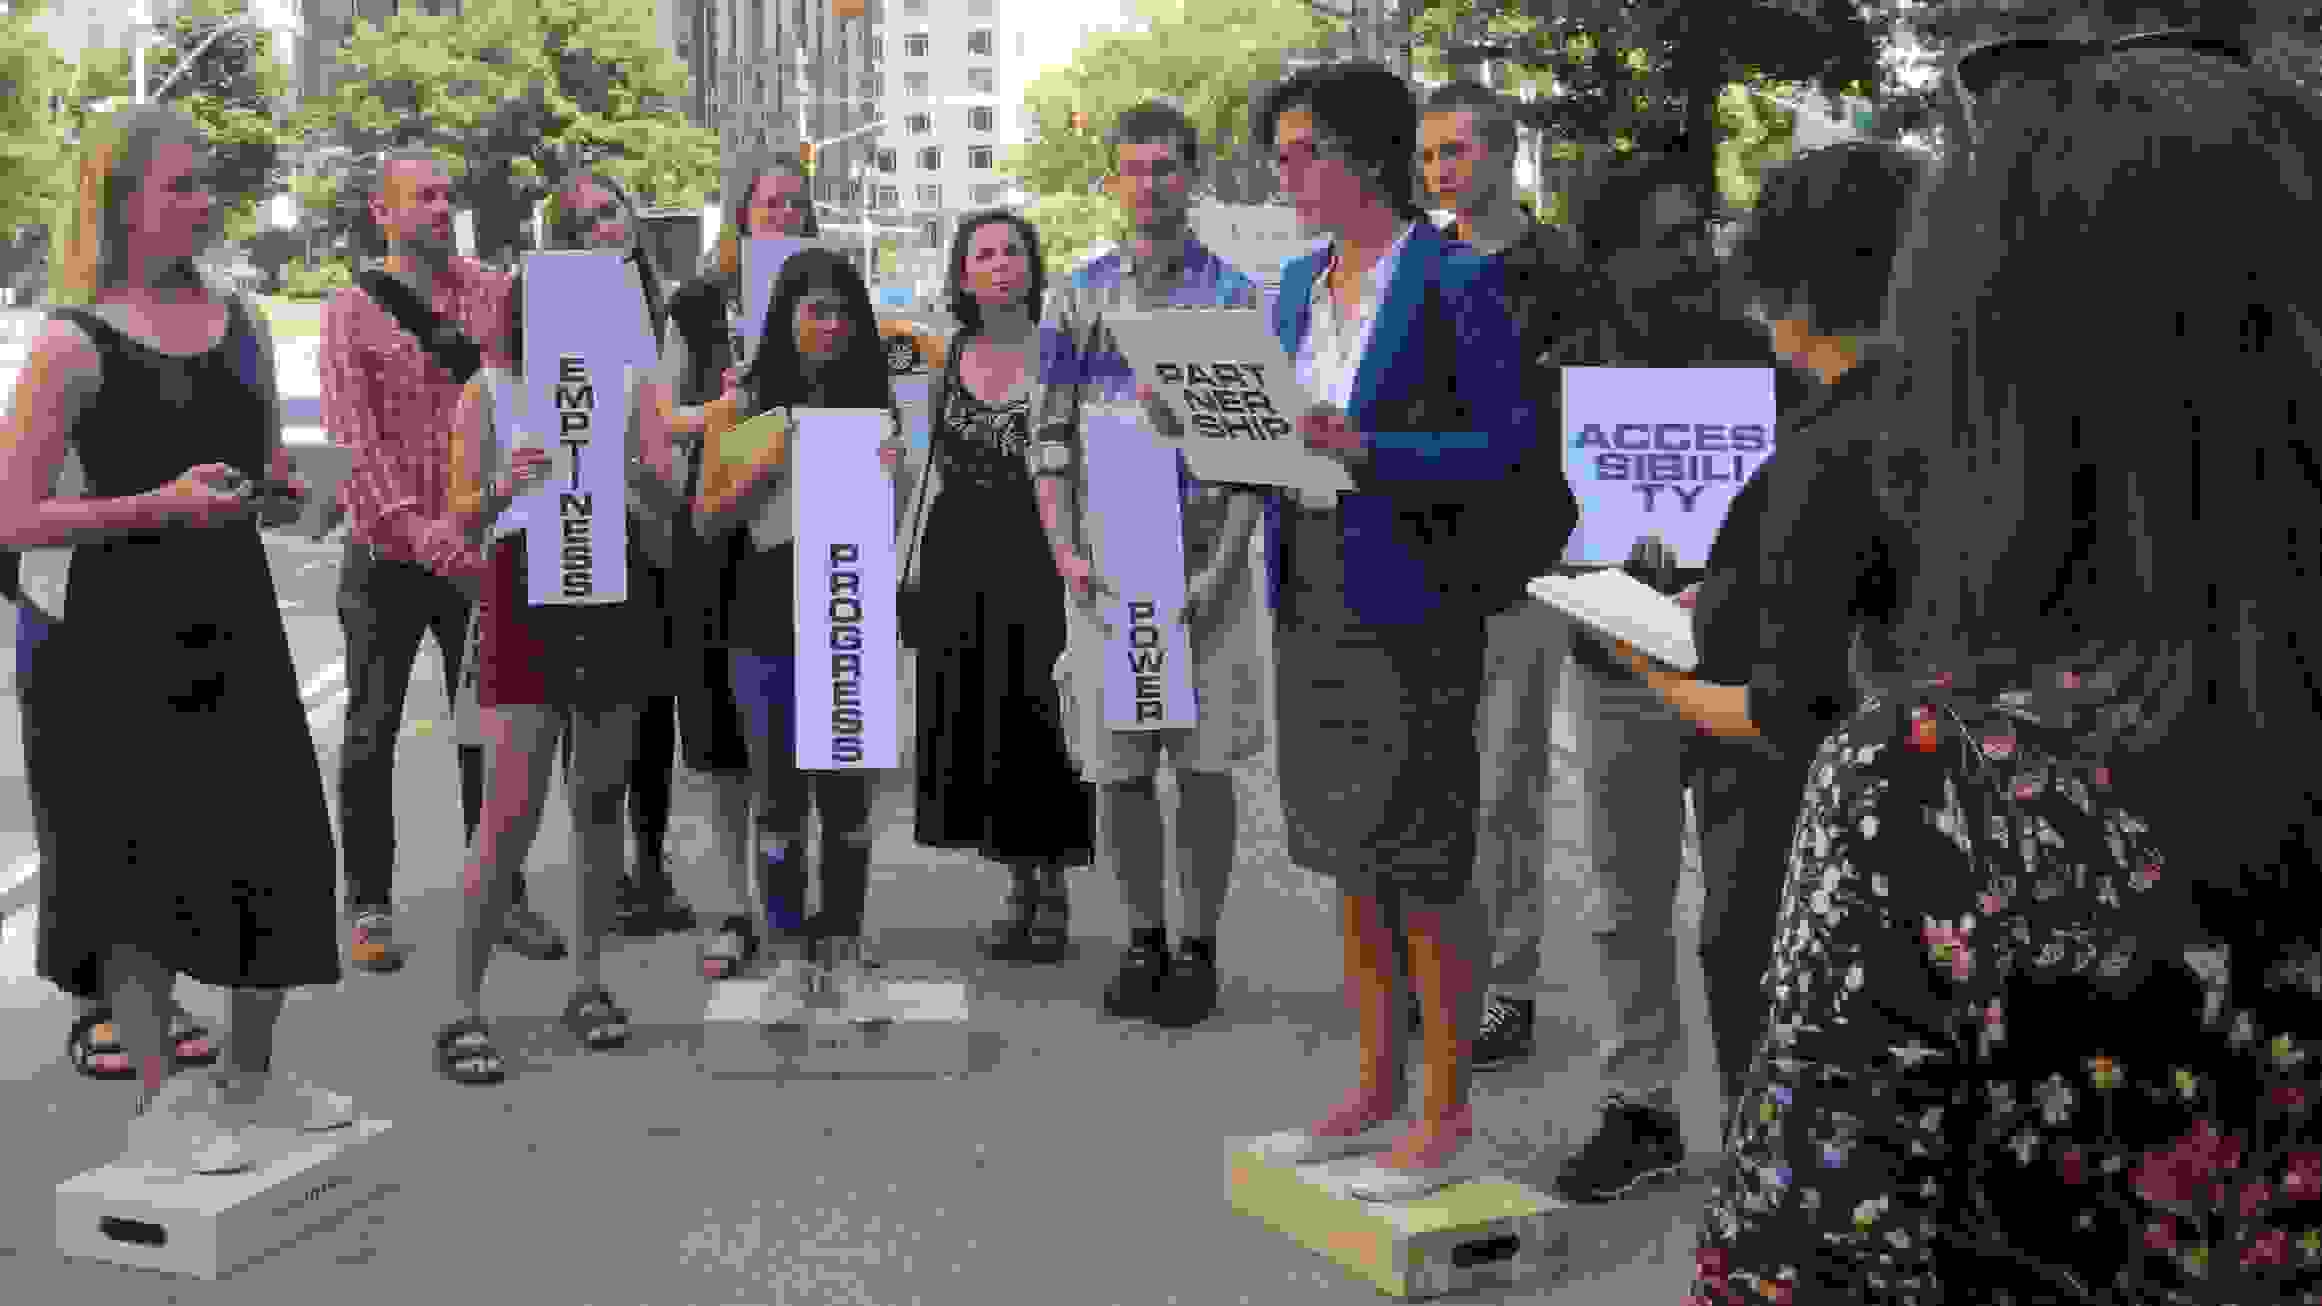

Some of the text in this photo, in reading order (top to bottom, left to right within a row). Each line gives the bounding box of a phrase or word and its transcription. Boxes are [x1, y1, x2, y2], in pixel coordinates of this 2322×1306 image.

[1155, 363, 1264, 385] PART
[1184, 389, 1274, 416] NER
[1194, 413, 1292, 440] SHIP
[1573, 423, 1770, 450] ACCES
[554, 356, 593, 598] EMPTINESS
[1594, 453, 1744, 480] SIBILI
[1632, 482, 1704, 513] TY
[829, 544, 863, 766] PROGRESS
[1127, 601, 1166, 724] POWER
